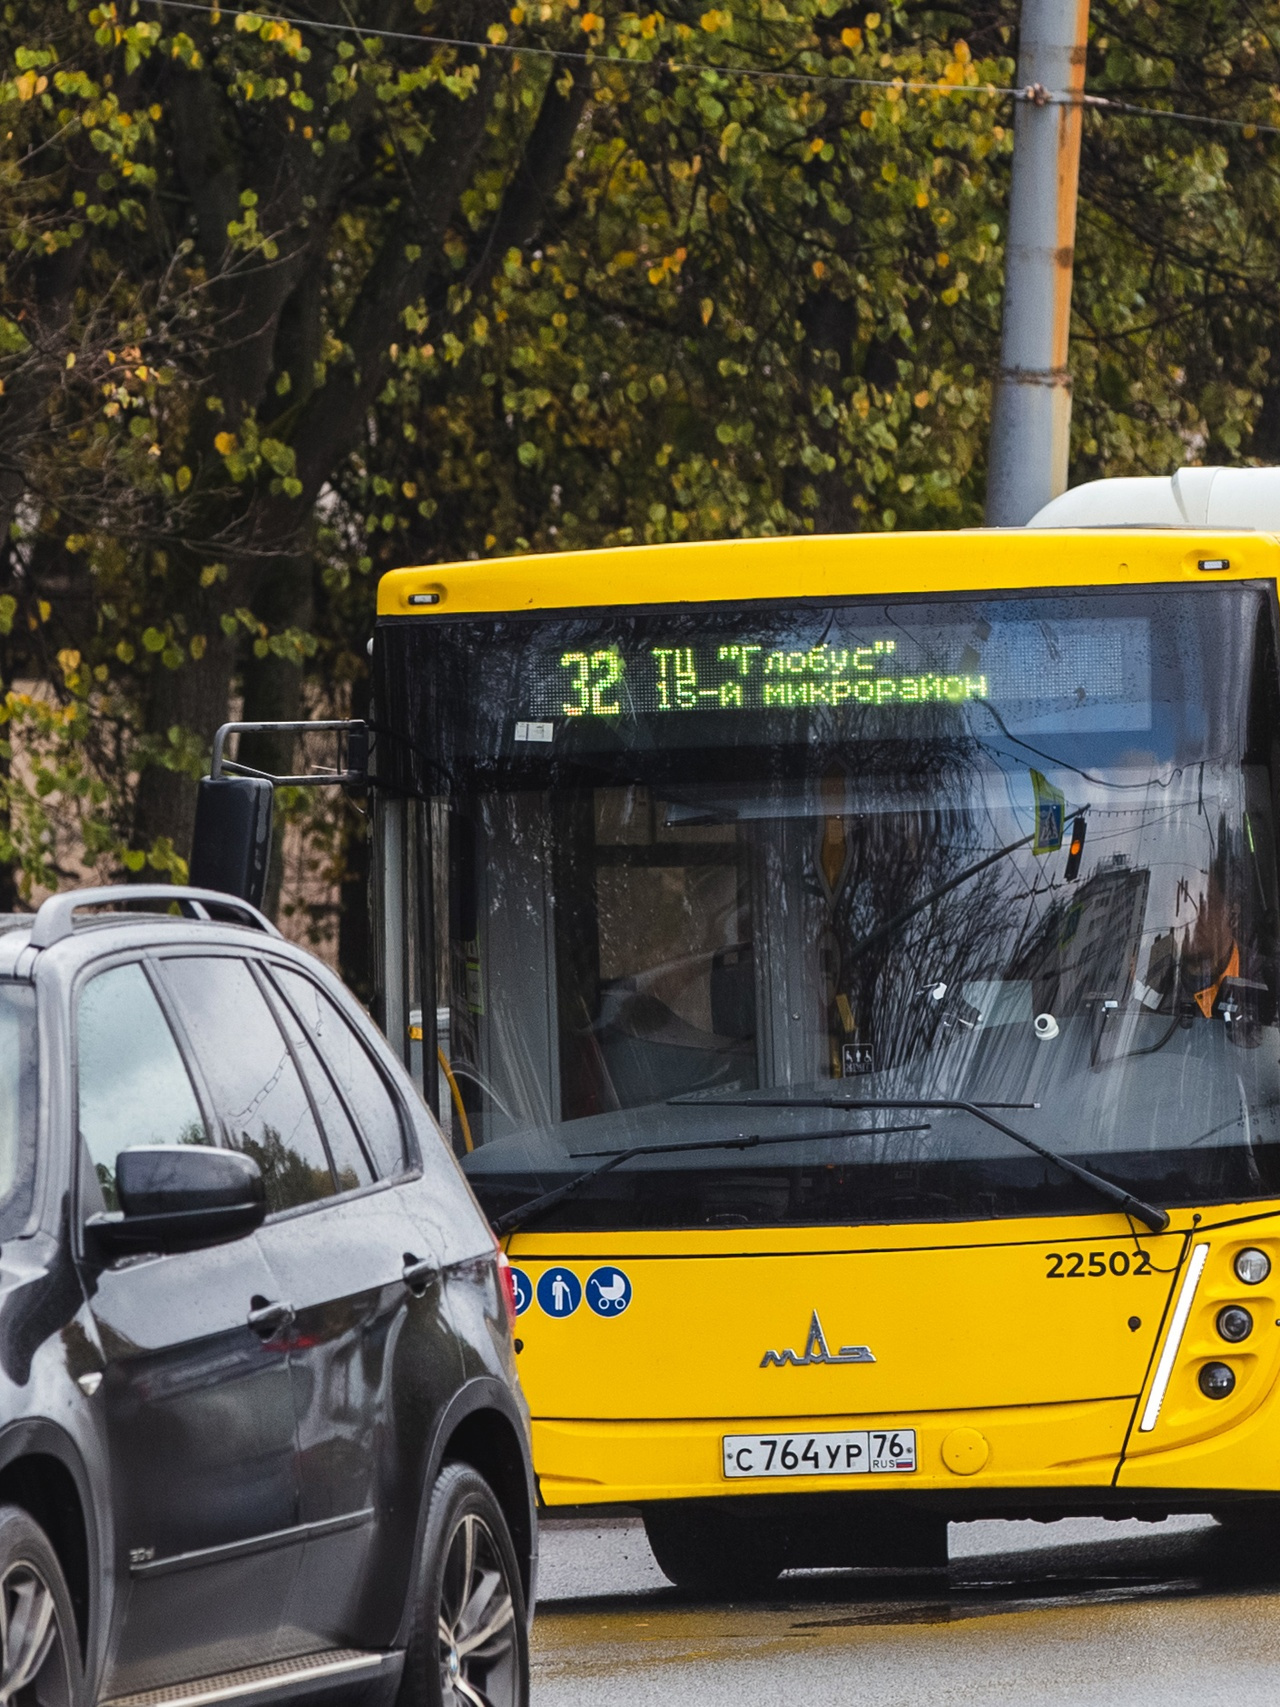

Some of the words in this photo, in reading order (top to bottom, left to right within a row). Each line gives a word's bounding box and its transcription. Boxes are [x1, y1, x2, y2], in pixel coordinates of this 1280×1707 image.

[652, 648, 696, 684] ТЦ
[718, 641, 896, 676] "Глобус"
[560, 651, 620, 716] 32
[763, 673, 988, 706] микрорайон
[1045, 1250, 1152, 1278] 22502
[872, 1433, 904, 1459] 76
[872, 1458, 896, 1469] RUS
